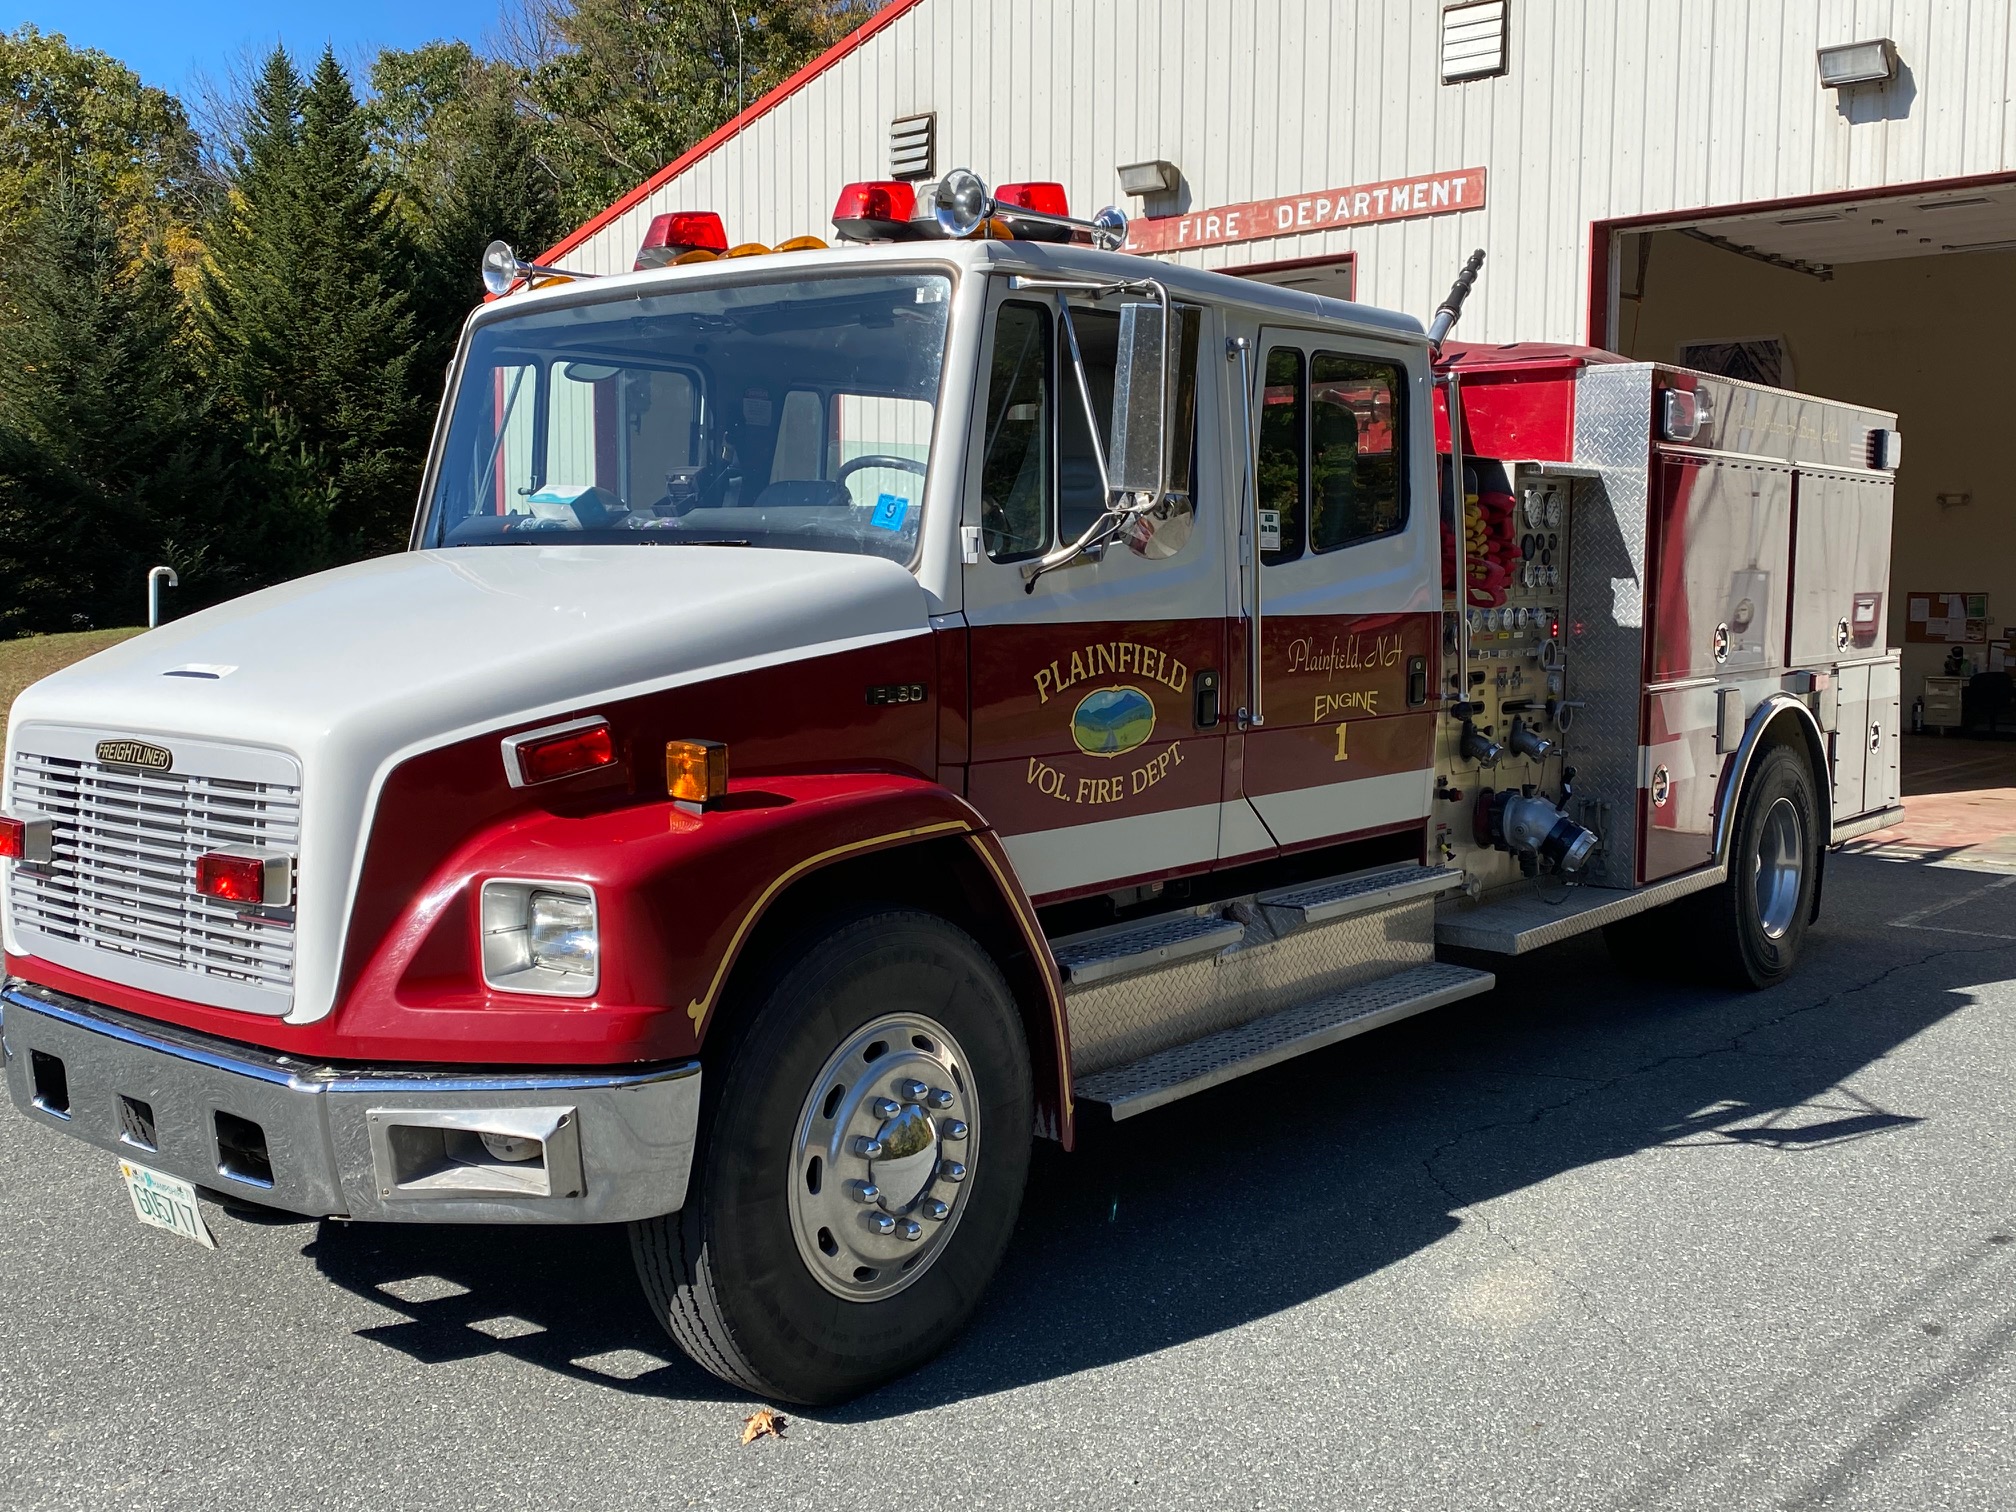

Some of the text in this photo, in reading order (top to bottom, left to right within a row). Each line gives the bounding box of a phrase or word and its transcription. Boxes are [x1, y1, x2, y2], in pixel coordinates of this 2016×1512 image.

[1178, 212, 1240, 243] FIRE
[1278, 177, 1468, 229] DEPARTMENT
[885, 502, 897, 519] 9
[1033, 642, 1187, 704] PLAINFIELD
[1288, 633, 1403, 682] Plainfield, NH
[1314, 690, 1379, 723] ENGINE
[97, 742, 167, 766] FREIGHTLINER
[1334, 722, 1348, 762] 1
[1027, 740, 1185, 804] VOL. FIRE DEPT.
